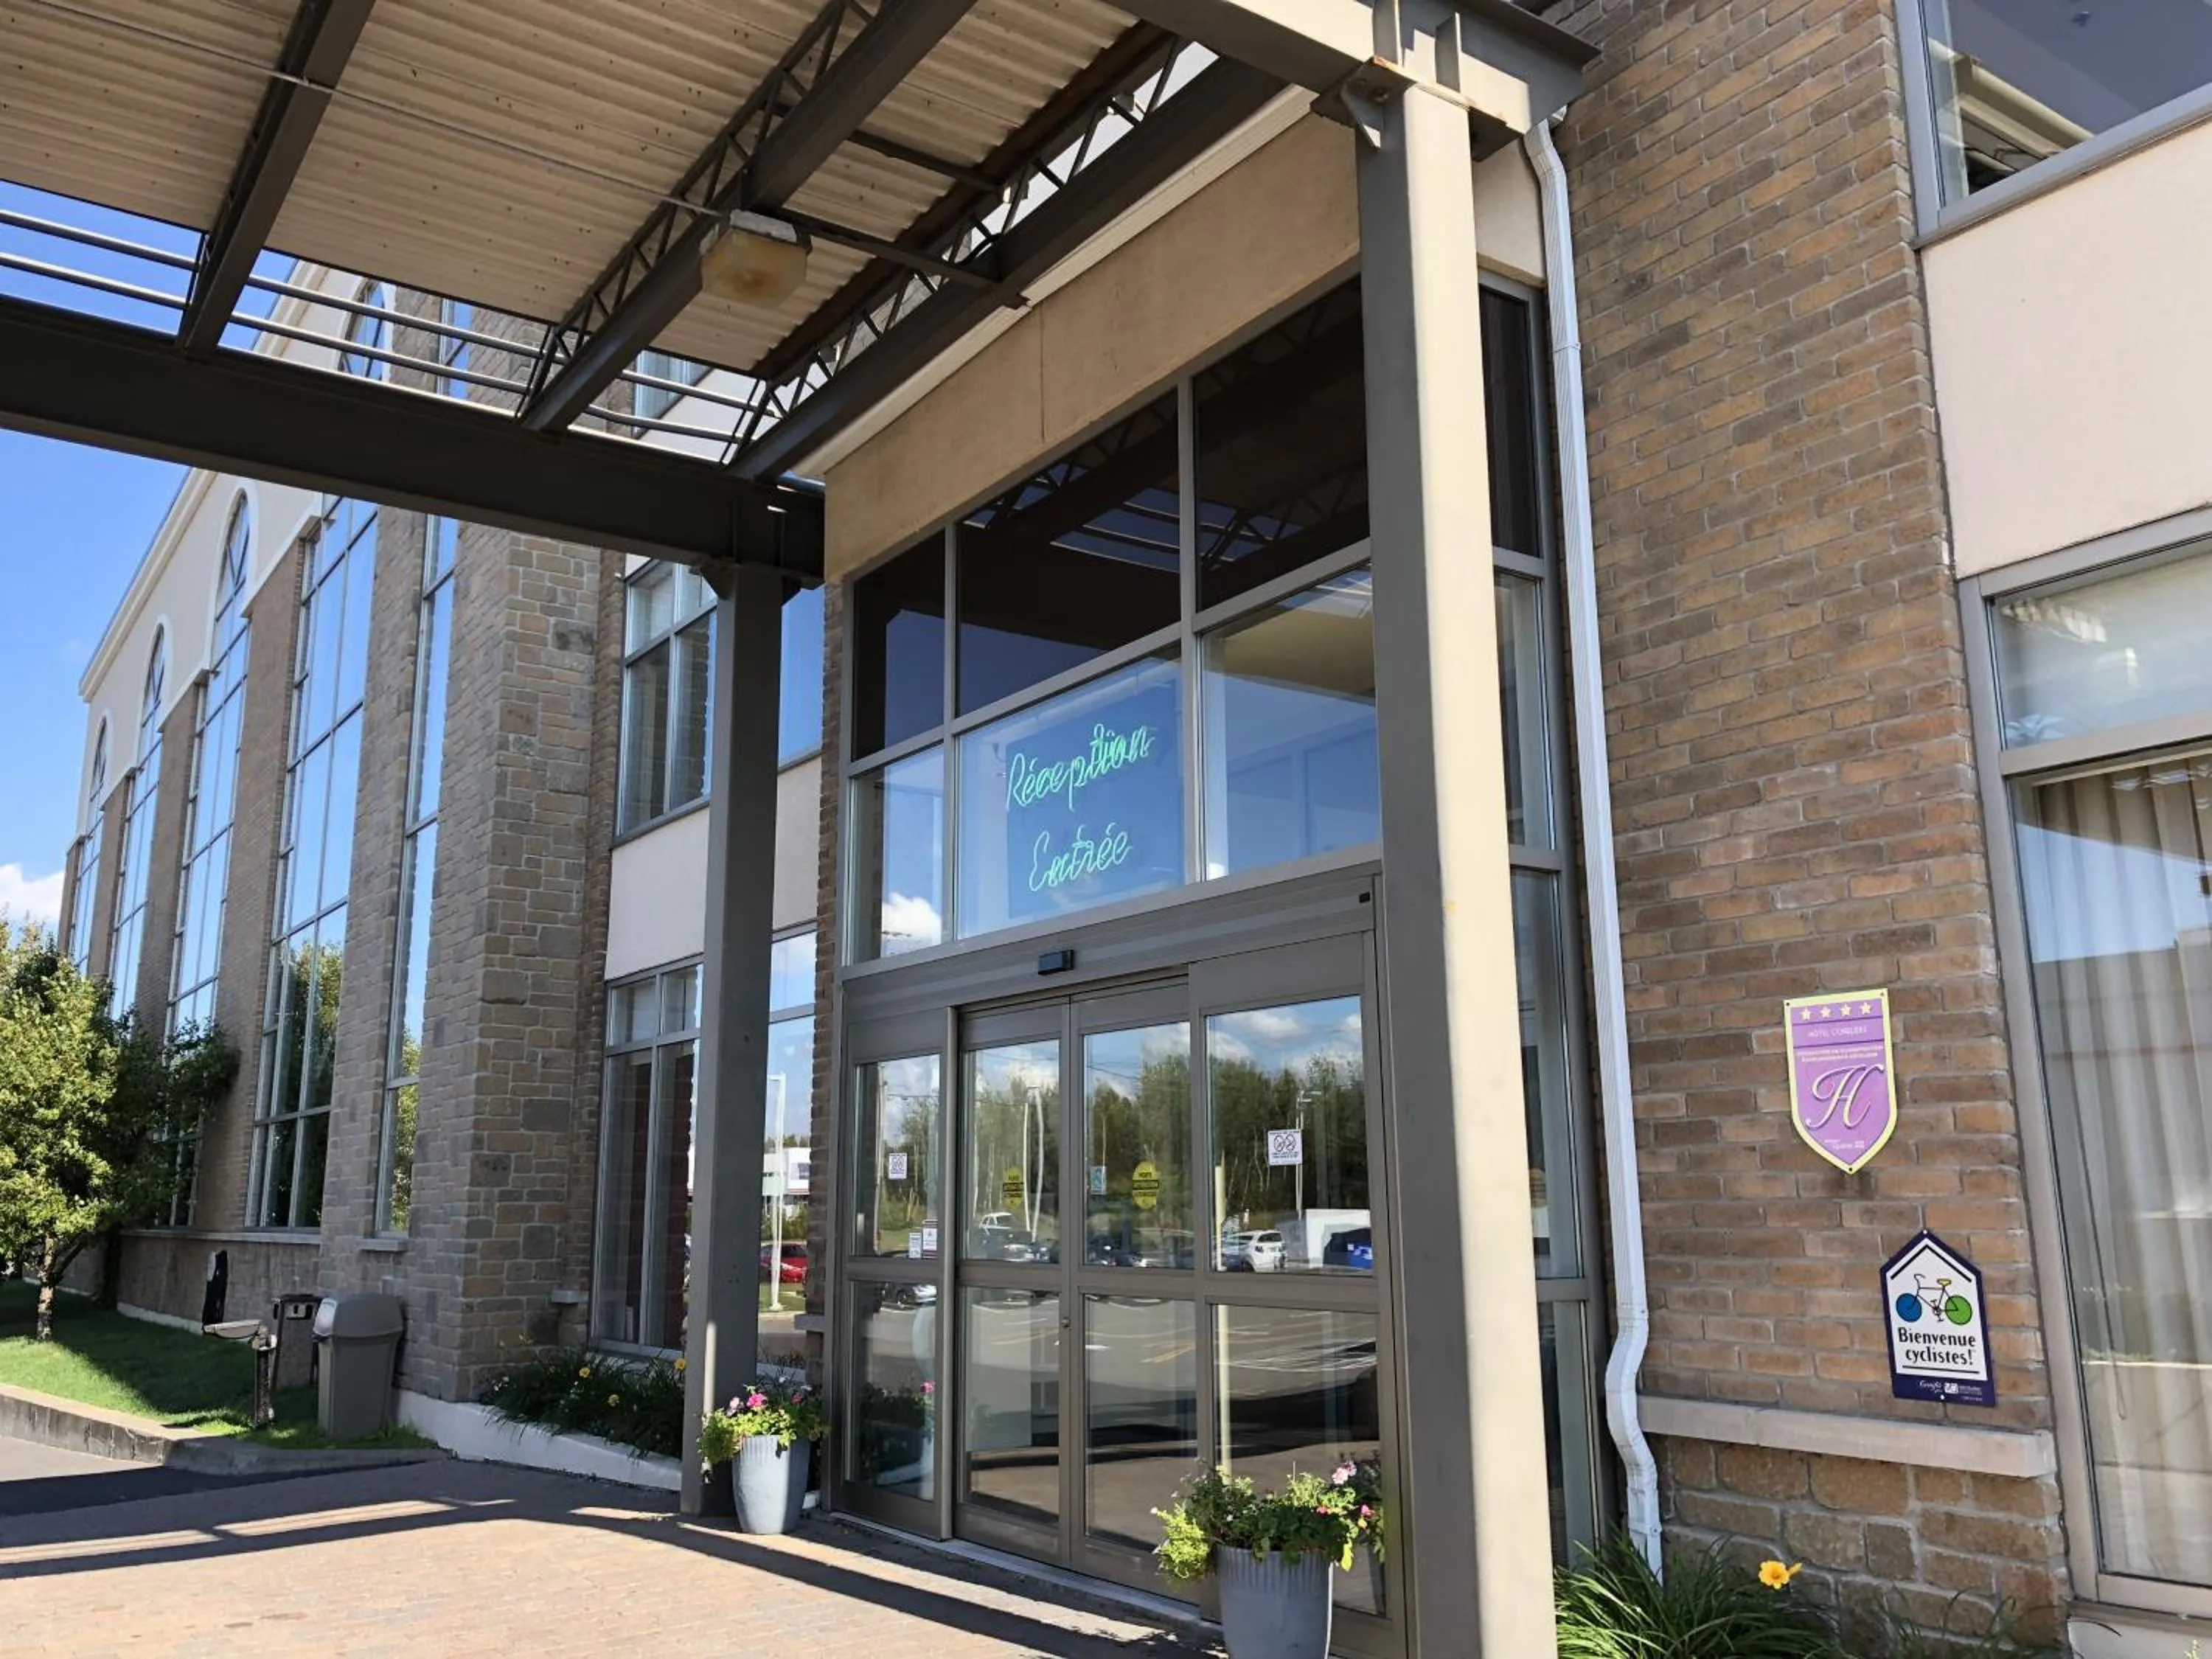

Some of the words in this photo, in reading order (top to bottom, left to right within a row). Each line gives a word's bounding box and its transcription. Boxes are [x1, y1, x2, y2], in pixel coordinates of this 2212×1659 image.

[1006, 724, 1156, 811] Réception
[1029, 823, 1133, 891] Entrée
[1898, 1327, 1976, 1347] Bienvenue
[1905, 1347, 1973, 1365] cyclistes!
